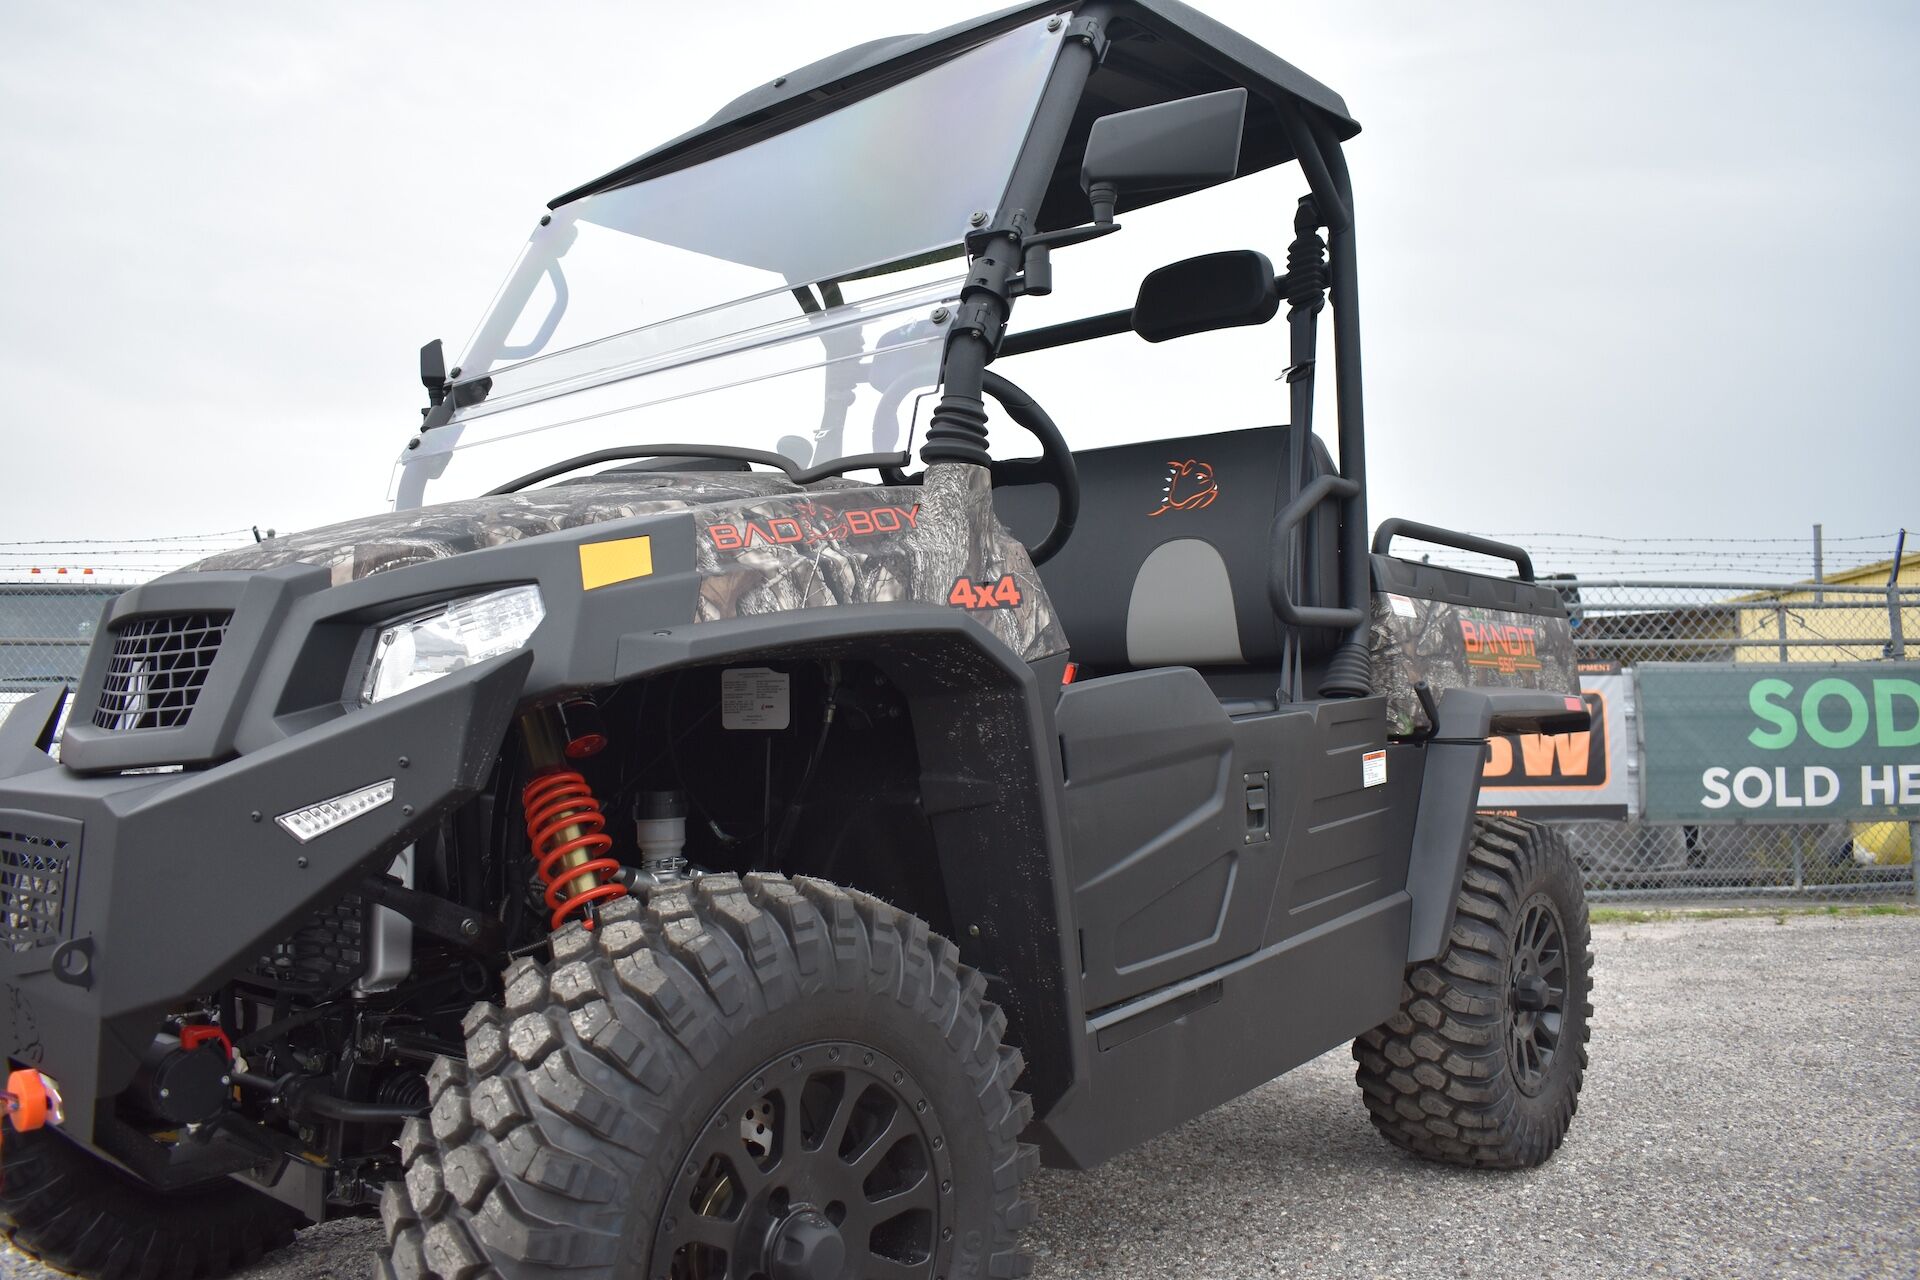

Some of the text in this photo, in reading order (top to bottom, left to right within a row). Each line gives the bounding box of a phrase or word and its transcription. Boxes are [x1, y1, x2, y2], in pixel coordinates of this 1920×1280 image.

[709, 504, 921, 549] BAD BOY
[950, 576, 1021, 609] 4x4
[1460, 619, 1536, 657] BANDIT
[1748, 678, 1920, 749] SOD
[1701, 764, 1920, 808] SOLD HE
